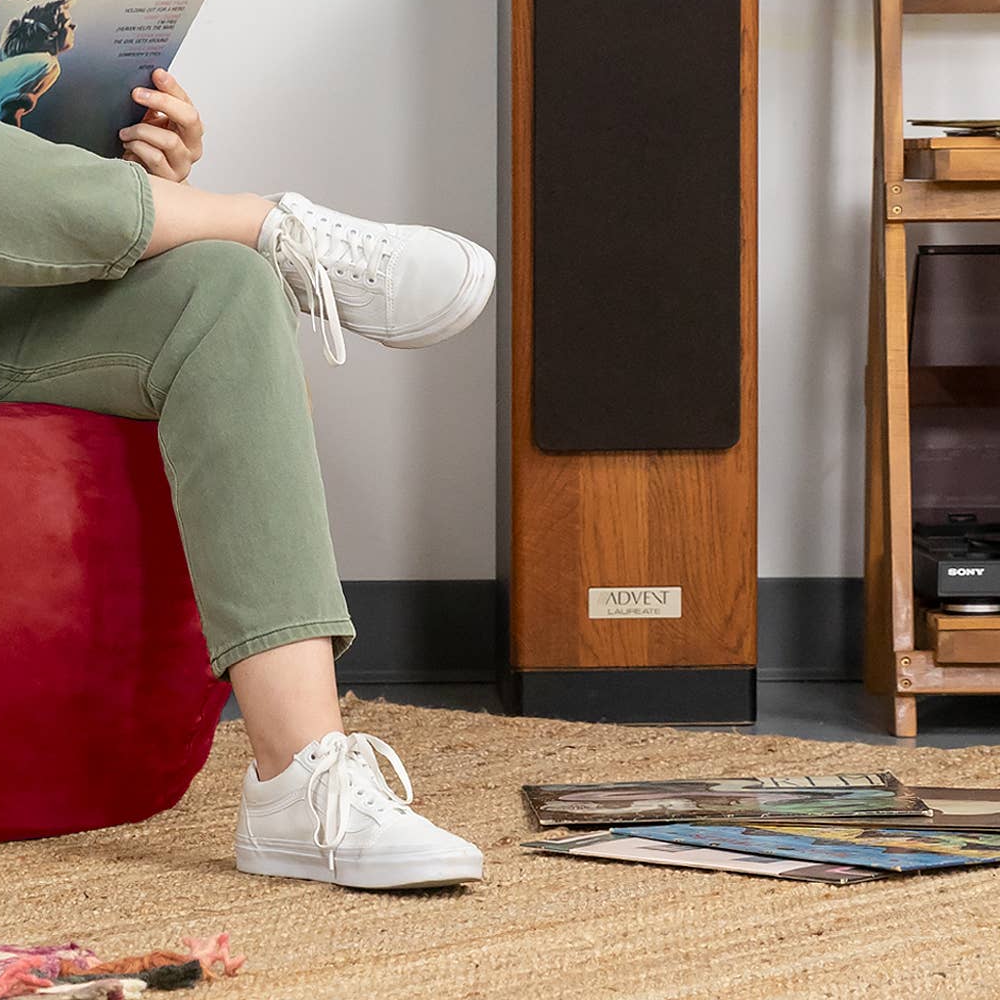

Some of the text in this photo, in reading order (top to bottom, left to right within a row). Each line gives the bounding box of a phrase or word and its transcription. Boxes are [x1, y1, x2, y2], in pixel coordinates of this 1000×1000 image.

[947, 568, 985, 576] SONY
[605, 591, 670, 606] ADVENT
[608, 608, 661, 616] LAUREATE
